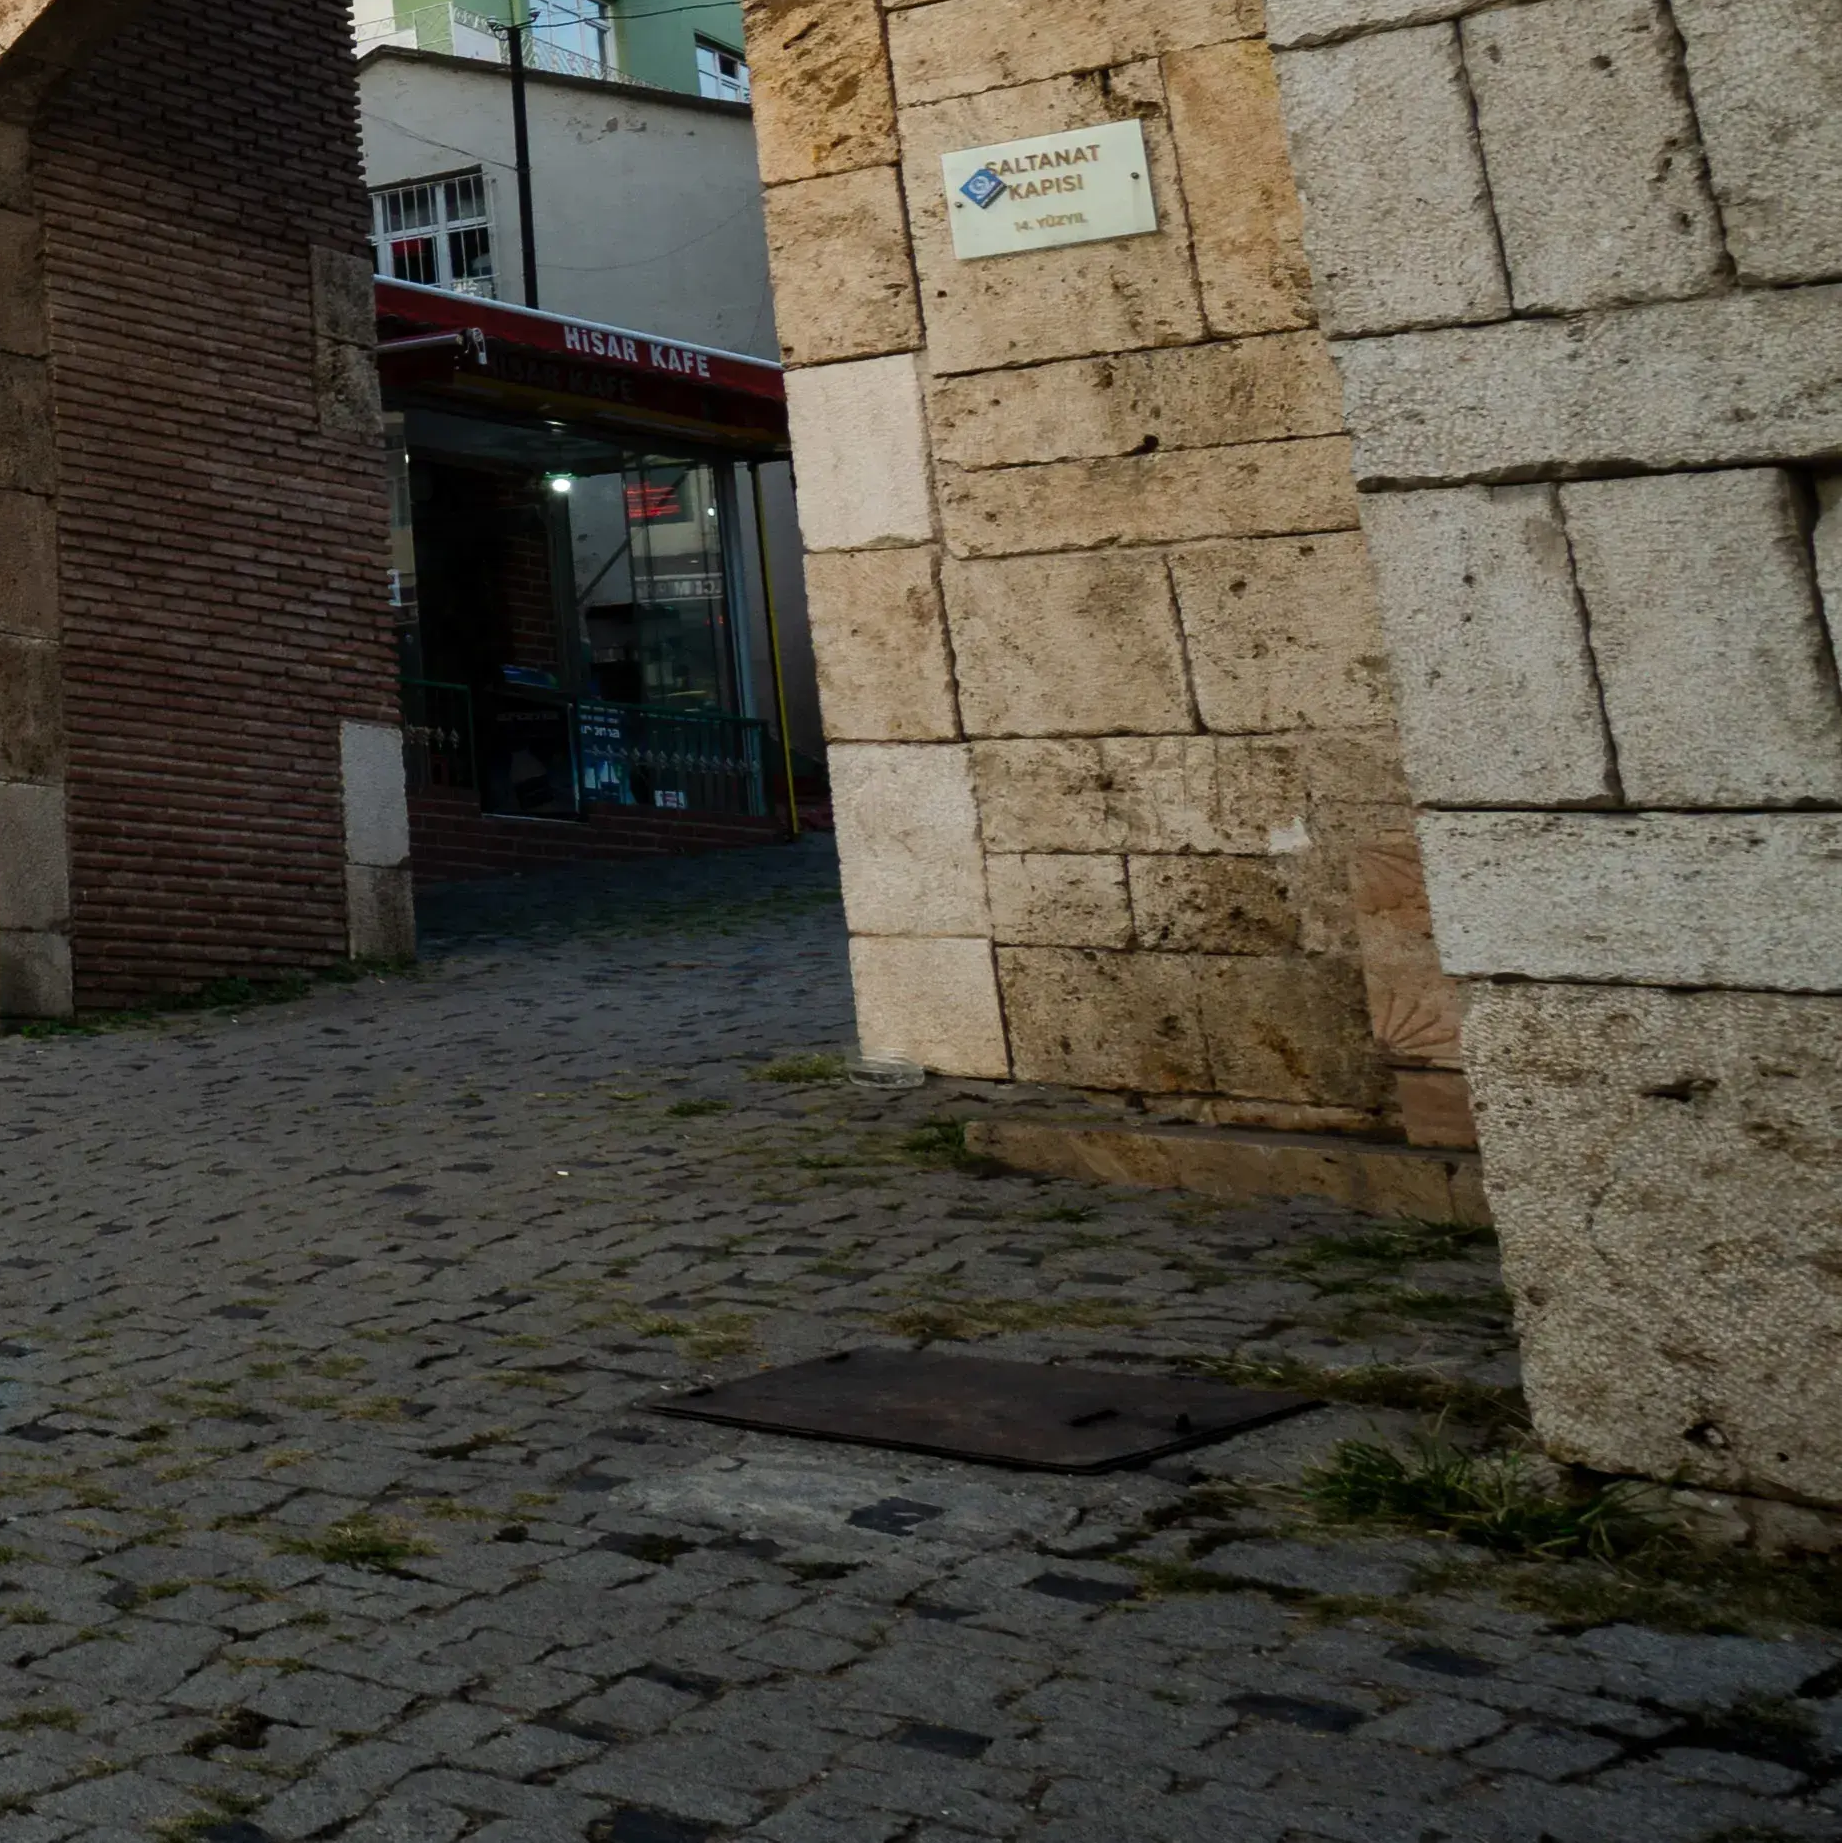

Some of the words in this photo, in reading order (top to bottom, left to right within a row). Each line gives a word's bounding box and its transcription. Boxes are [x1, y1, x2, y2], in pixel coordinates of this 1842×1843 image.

[985, 144, 1100, 176] SALTANAT
[1008, 173, 1084, 201] KAPISI
[1013, 220, 1034, 232] 14.
[649, 344, 710, 378] KAFE
[568, 368, 636, 403] KAFE
